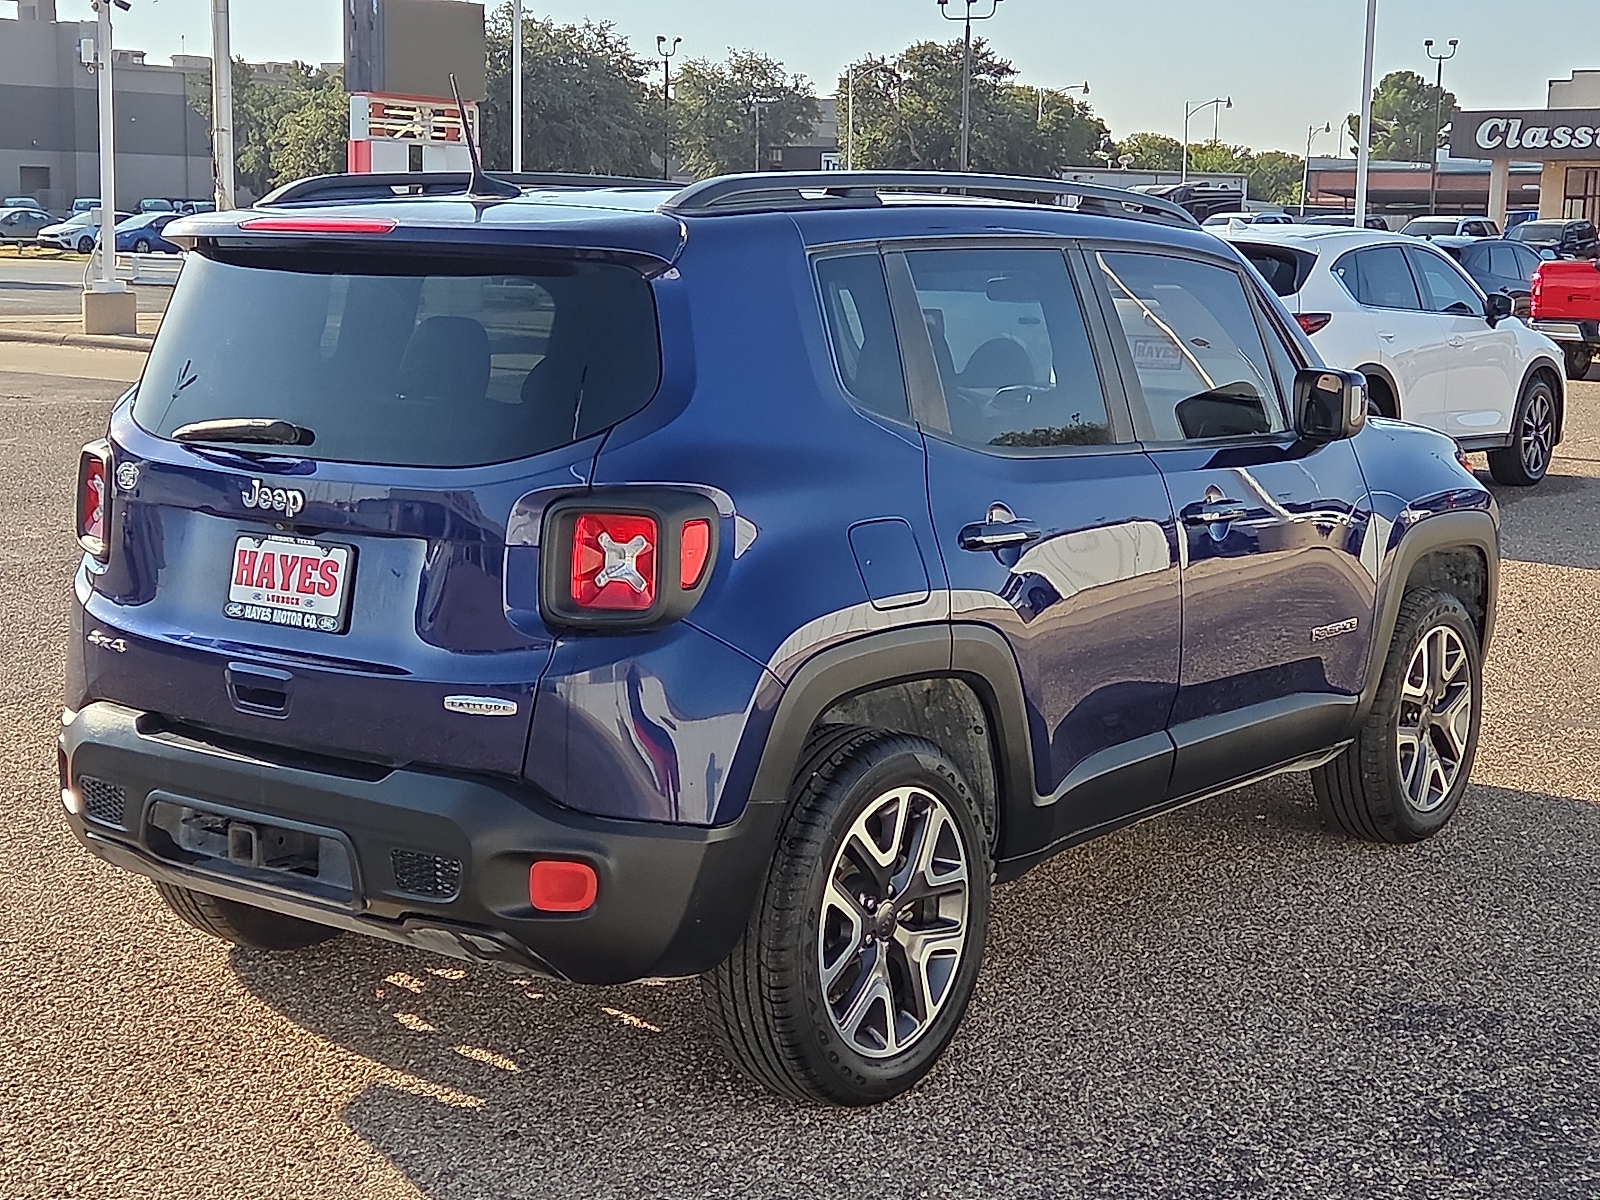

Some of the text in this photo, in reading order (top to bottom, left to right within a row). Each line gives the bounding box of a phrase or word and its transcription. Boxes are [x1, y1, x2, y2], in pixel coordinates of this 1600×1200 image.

[242, 479, 304, 517] Jeep
[234, 549, 340, 597] HAYES
[266, 593, 300, 606] LUBBOCK
[244, 605, 318, 629] HAYES MOTOR CO.
[449, 701, 509, 712] LATITUDE
